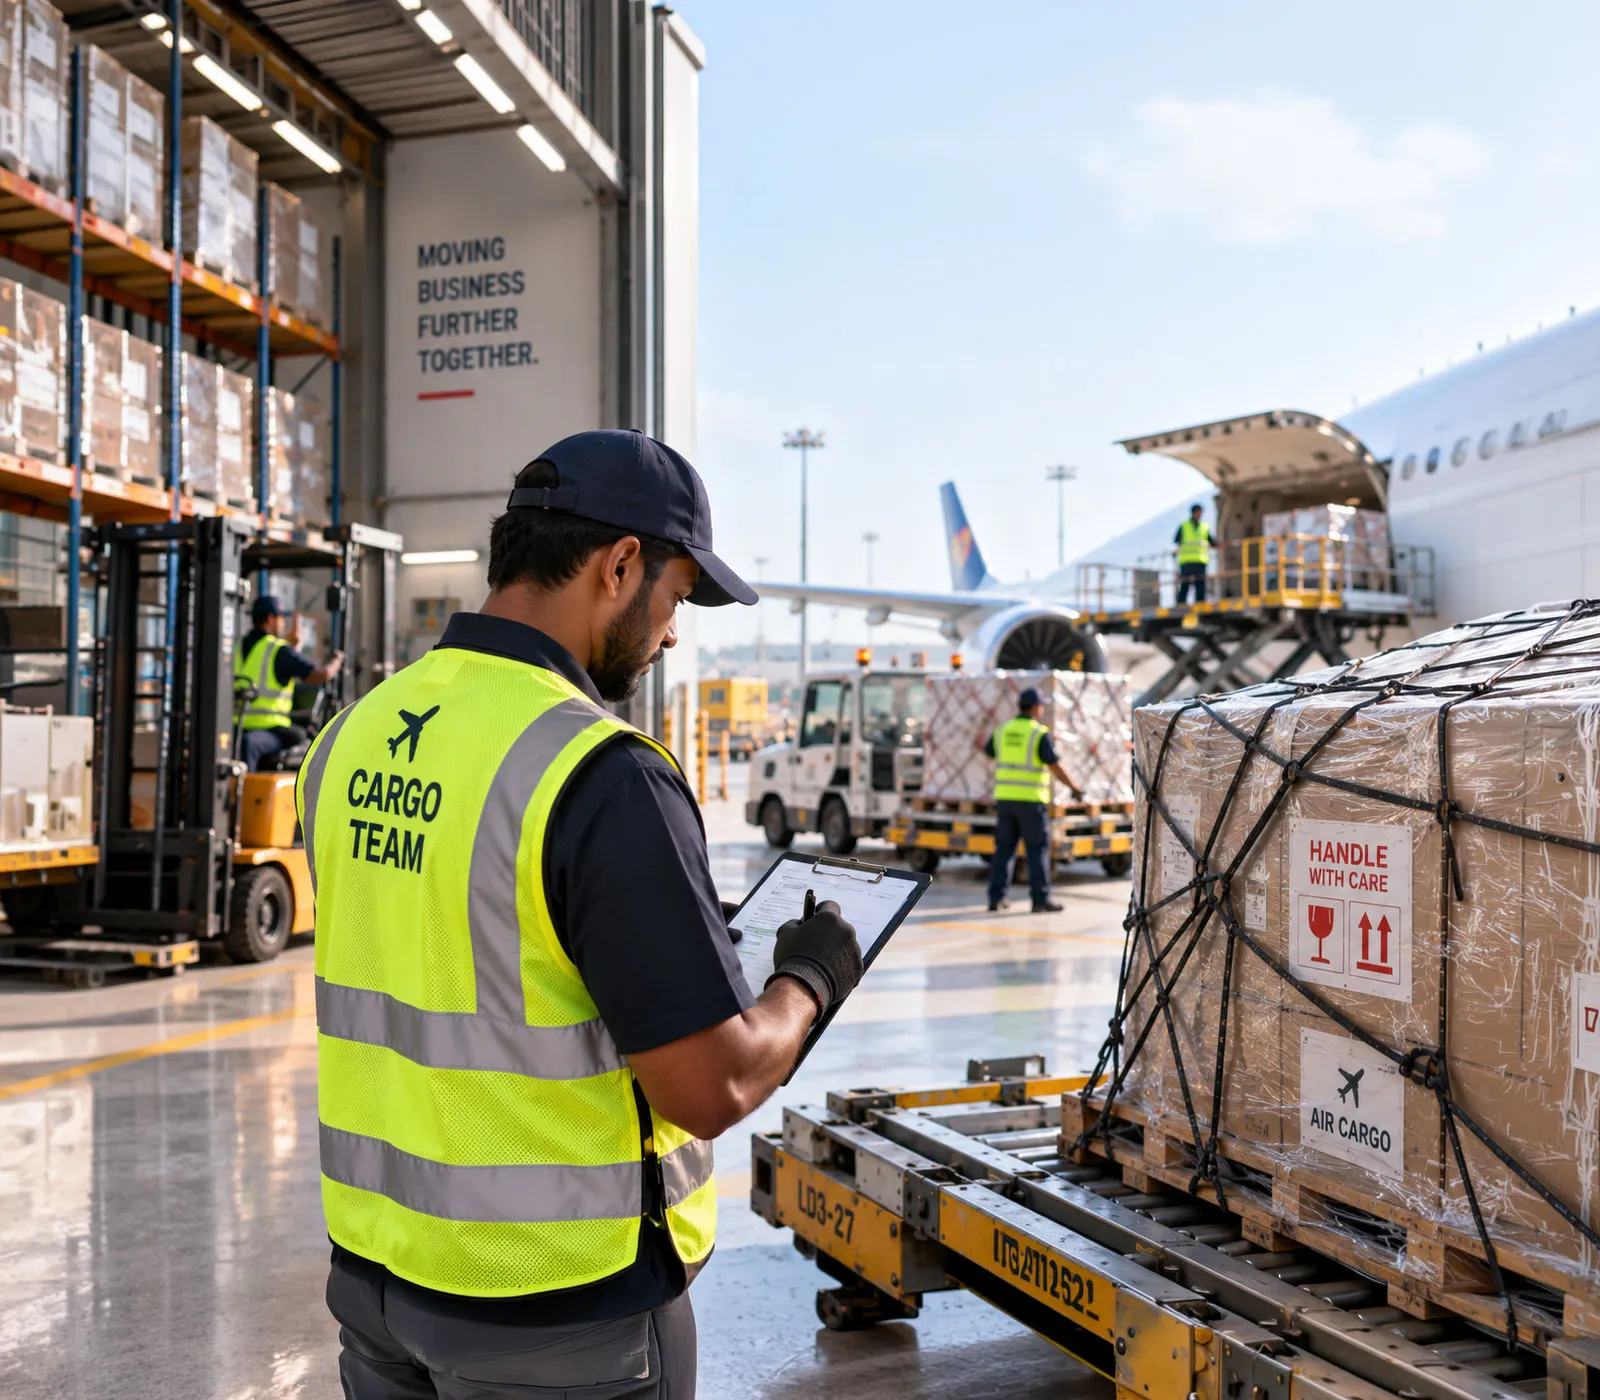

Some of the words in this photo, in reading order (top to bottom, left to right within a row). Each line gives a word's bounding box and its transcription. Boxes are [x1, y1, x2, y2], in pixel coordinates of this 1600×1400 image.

[417, 237, 505, 268] MOVING
[418, 270, 525, 304] BUSINESS
[418, 307, 518, 339] FURTHER
[417, 341, 539, 373] TOGETHER.
[348, 768, 442, 823] CARGO
[349, 818, 425, 874] TEAM
[1310, 840, 1388, 868] HANDLE
[1309, 867, 1344, 887] WITH
[1348, 871, 1388, 893] CARE
[1310, 1107, 1334, 1134] AIR
[1338, 1116, 1391, 1153] CARGO
[798, 1179, 854, 1244] LD3-27
